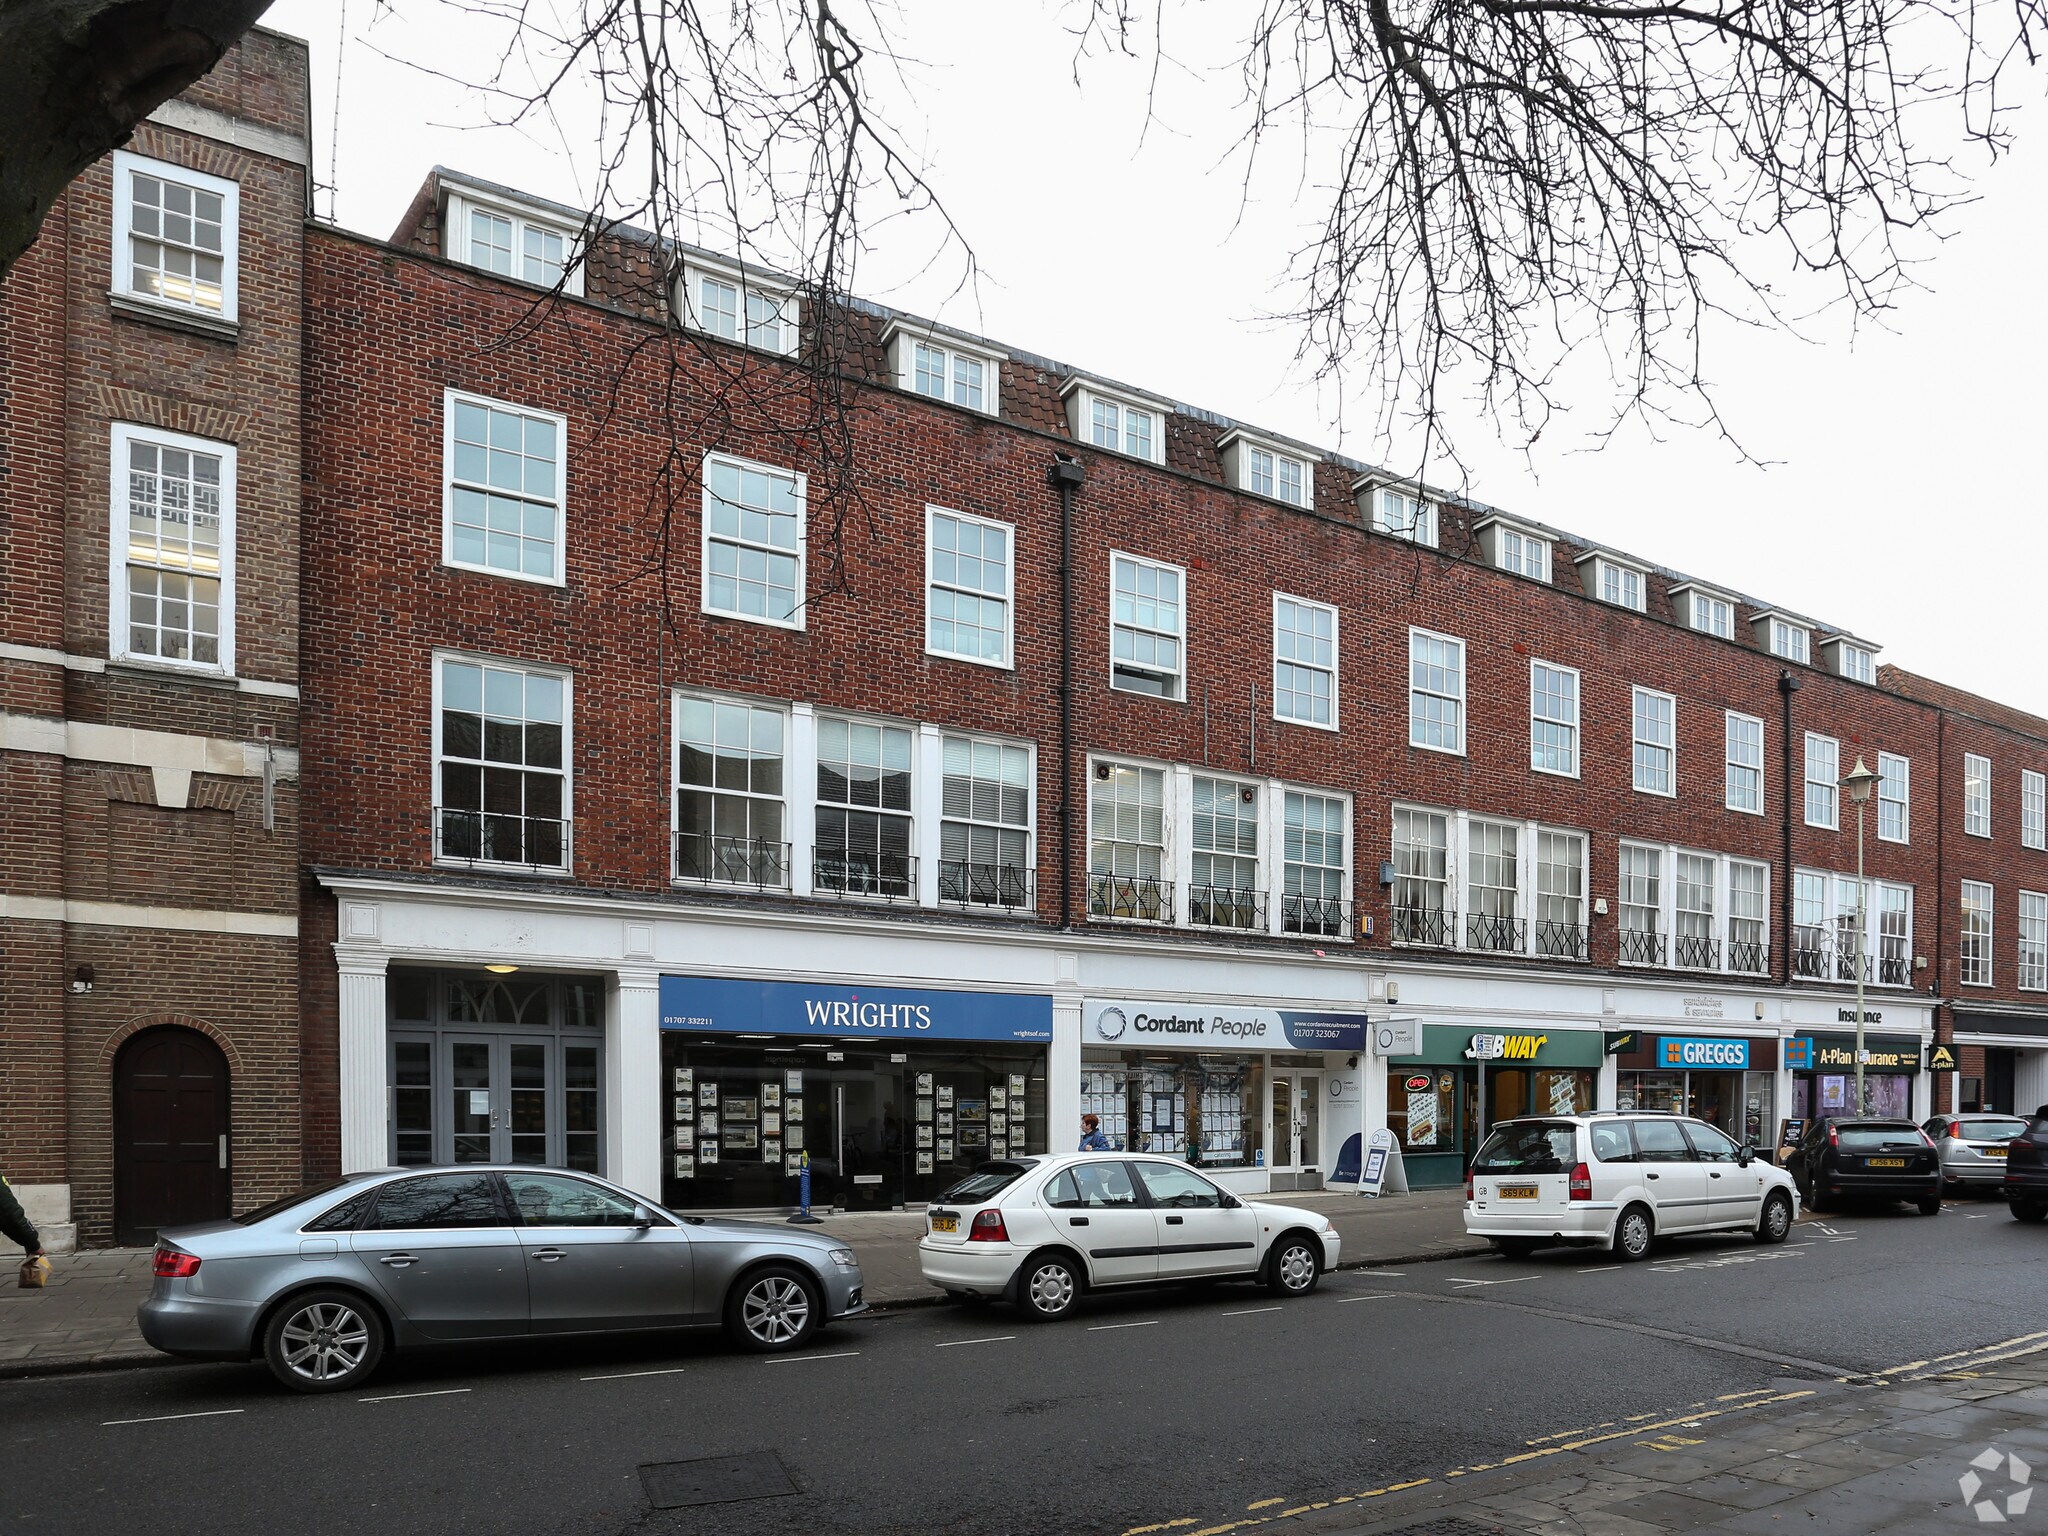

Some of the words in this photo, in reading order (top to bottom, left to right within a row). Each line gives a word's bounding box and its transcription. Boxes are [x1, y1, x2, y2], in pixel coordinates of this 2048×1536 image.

[804, 995, 931, 1030] WRIGHTS
[664, 1016, 686, 1025] 01707
[687, 1017, 713, 1025] 332211
[1134, 1013, 1204, 1034] Cordant
[1210, 1016, 1267, 1040] People
[1013, 1030, 1050, 1038] wrightsof.com
[1293, 1029, 1314, 1038] 01707
[1315, 1030, 1340, 1039] 323067
[1464, 1033, 1548, 1059] SBWAY
[1683, 1043, 1745, 1065] GREGGS
[1820, 1047, 1852, 1065] A-Plan
[1854, 1050, 1898, 1066] Iurance
[1930, 1061, 1954, 1069] a-plan
[1408, 1079, 1428, 1088] OPEN
[1213, 1151, 1232, 1159] catering
[1889, 1158, 1903, 1166] XSY
[1478, 1186, 1488, 1196] GB
[1502, 1188, 1518, 1197] S69
[1518, 1188, 1535, 1197] KLW
